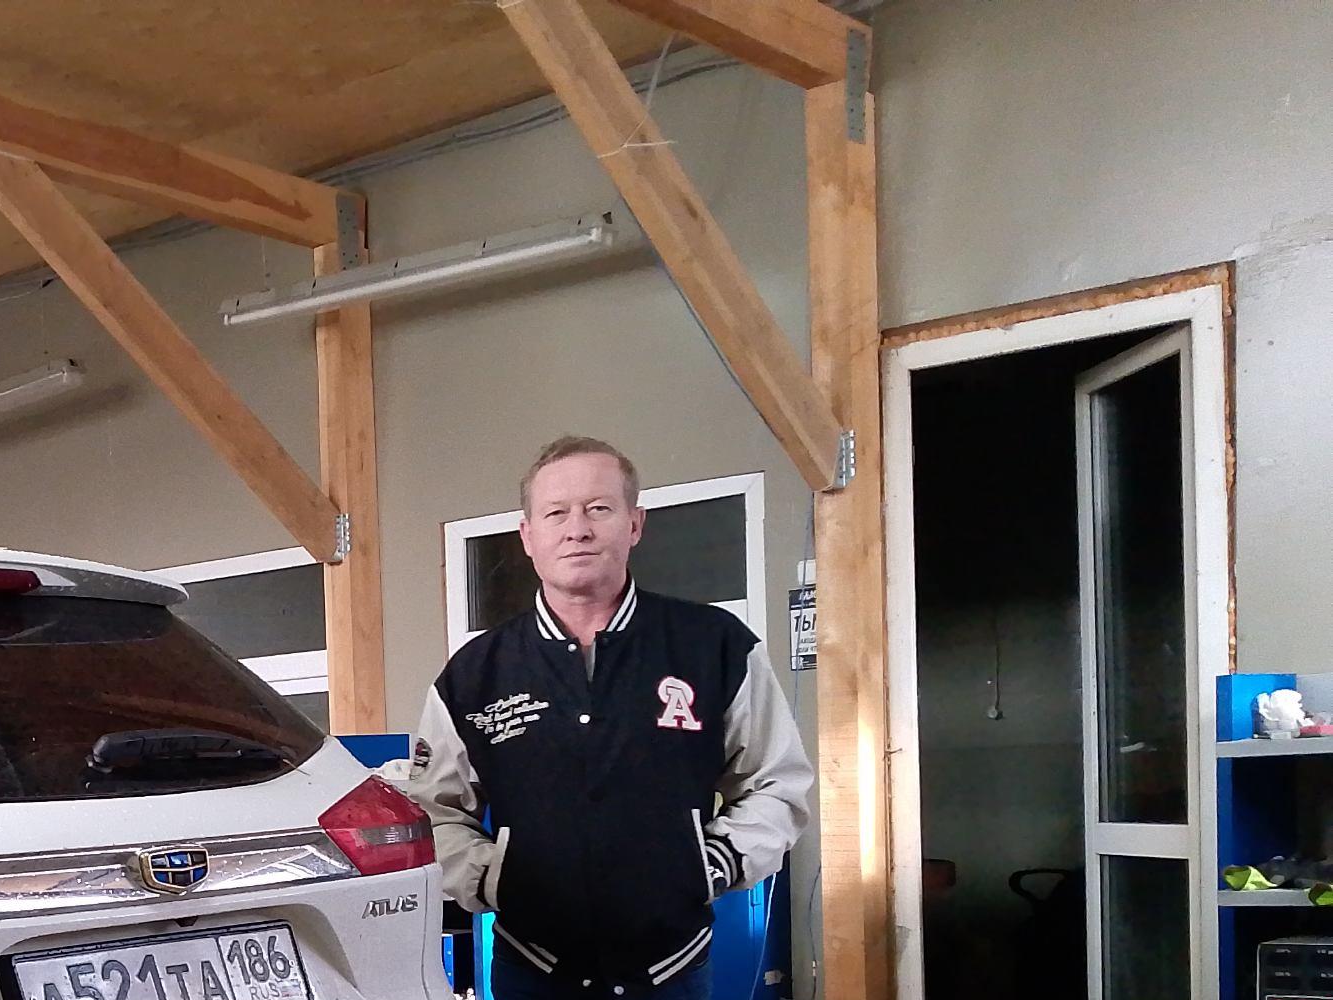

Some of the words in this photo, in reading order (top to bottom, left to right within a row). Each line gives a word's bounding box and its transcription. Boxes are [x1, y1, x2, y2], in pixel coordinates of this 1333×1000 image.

[361, 893, 419, 919] ATLAS
[227, 935, 292, 986] 186
[249, 984, 281, 1000] RUS
